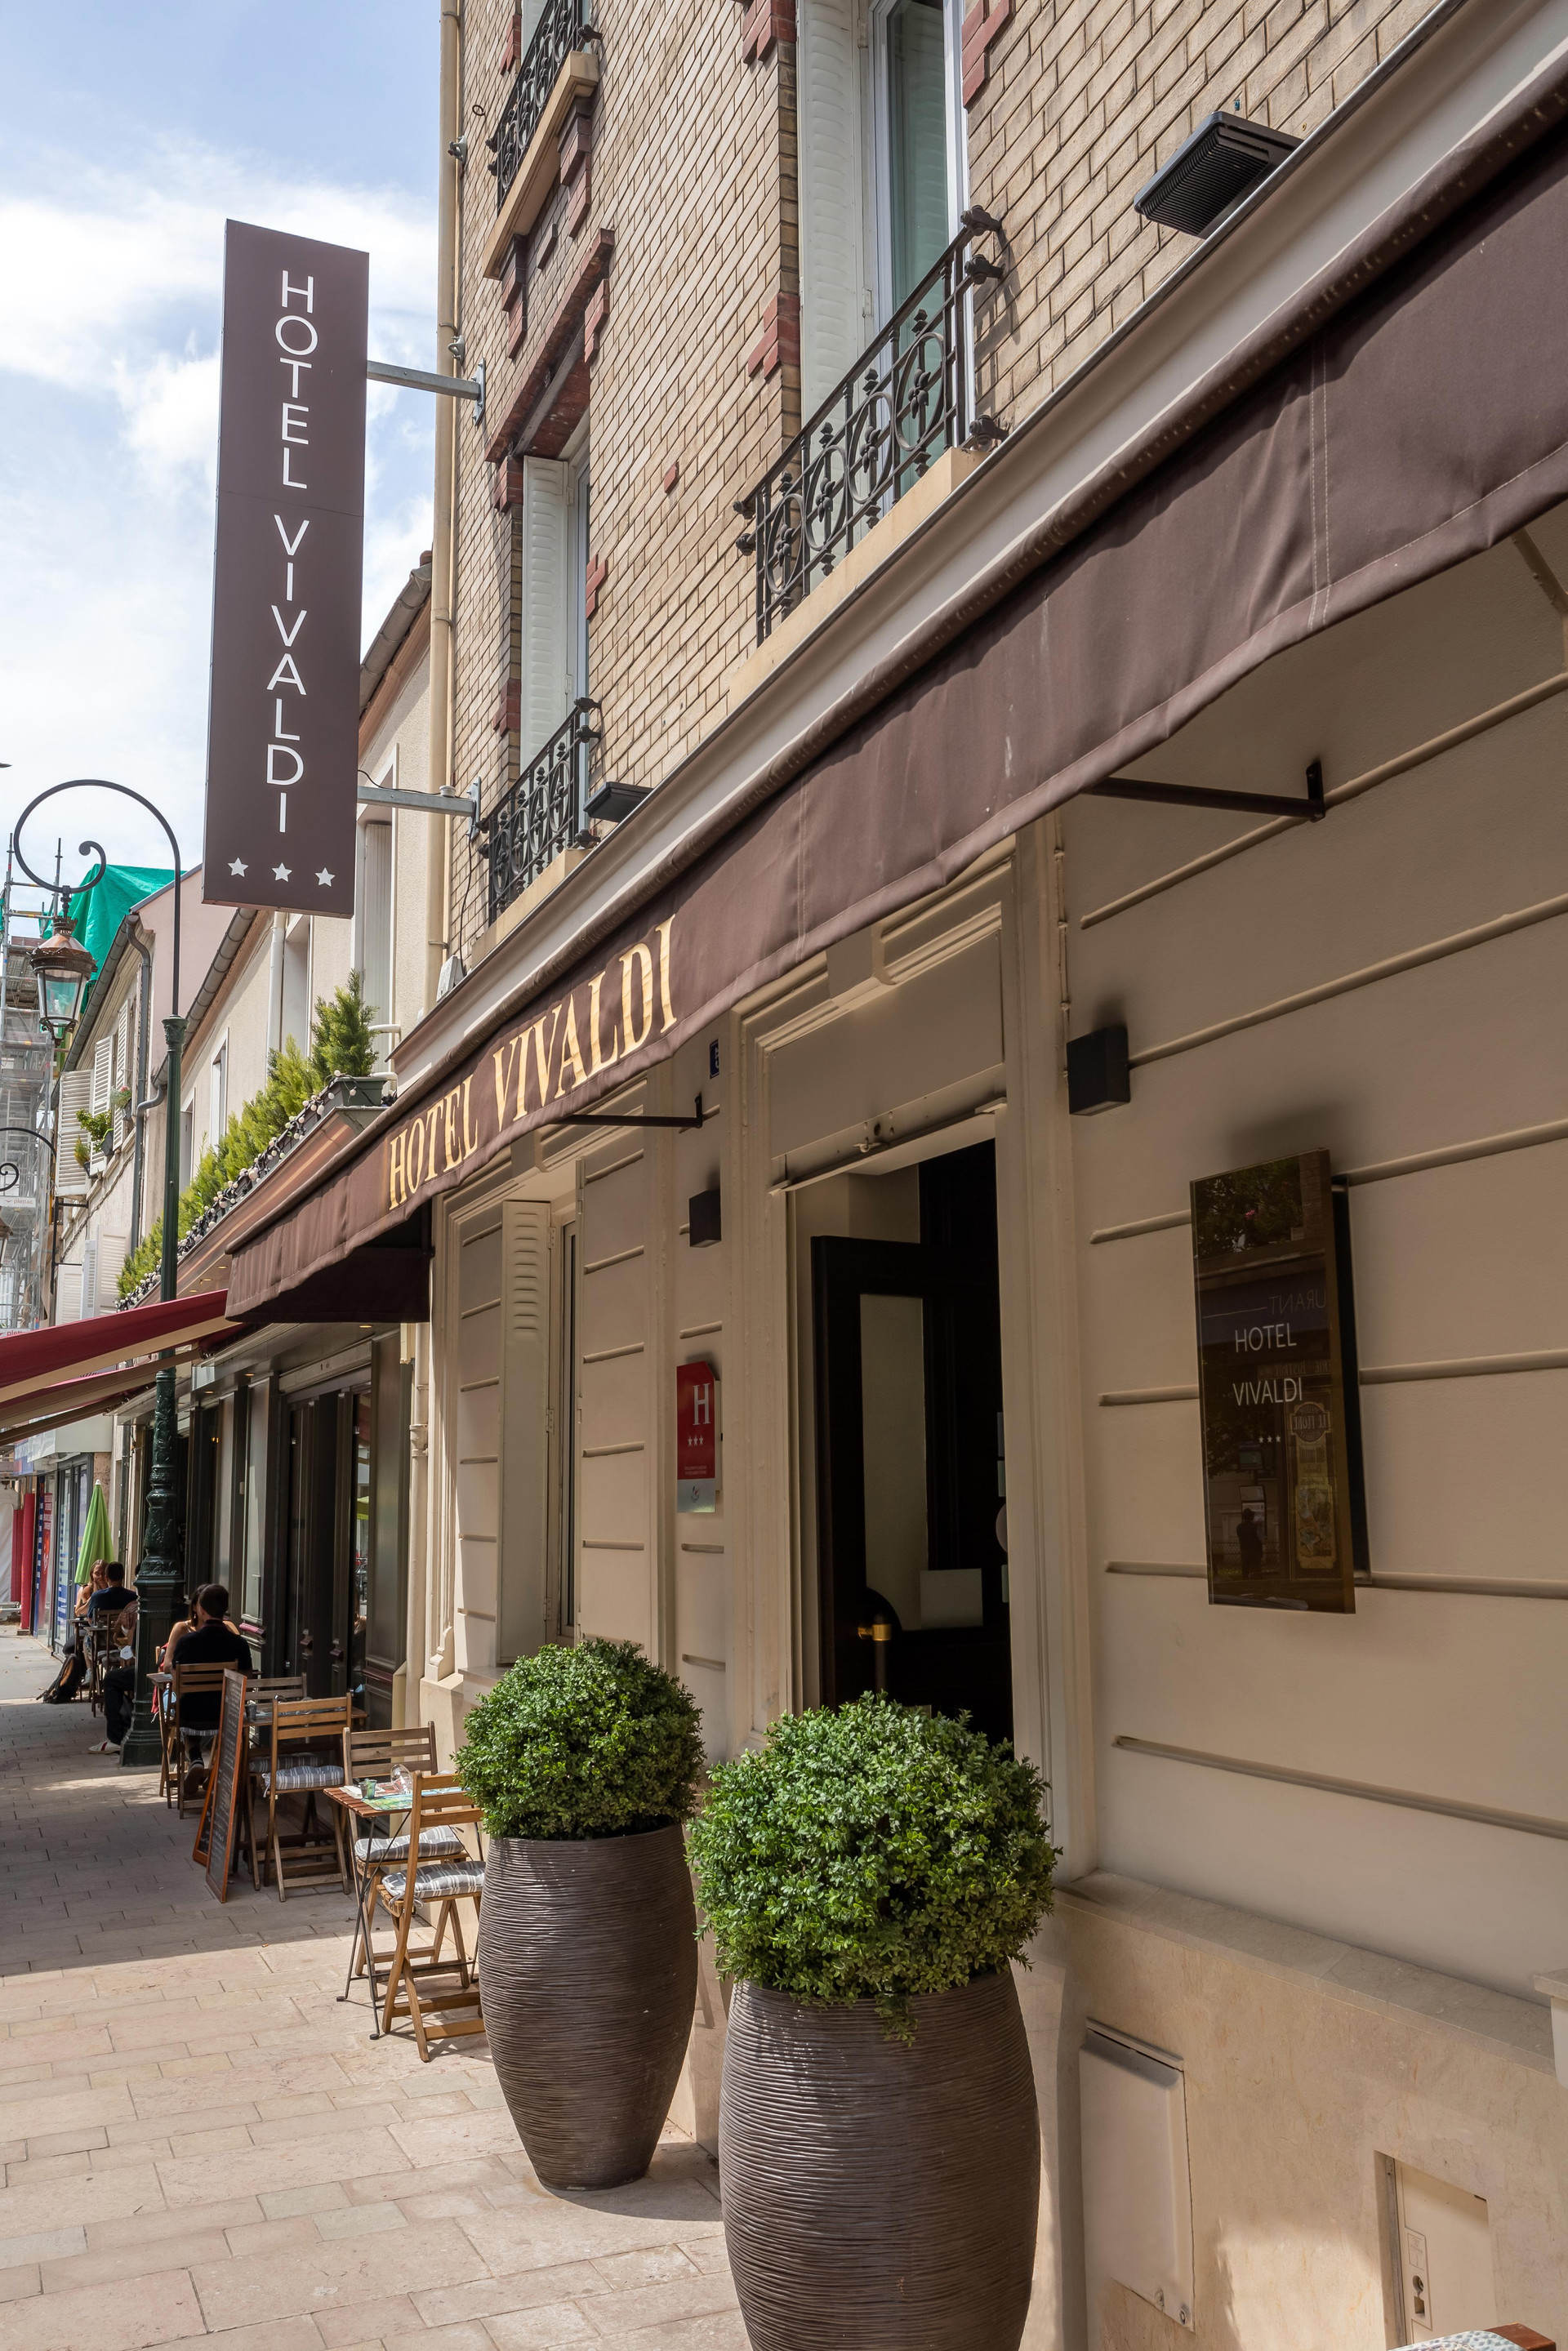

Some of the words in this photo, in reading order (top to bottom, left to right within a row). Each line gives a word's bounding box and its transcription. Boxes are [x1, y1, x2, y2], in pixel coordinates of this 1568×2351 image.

[274, 269, 318, 490] HOTEL
[265, 514, 310, 833] VIVALDI
[389, 1074, 479, 1210] HOTEL
[492, 914, 678, 1132] VIVALDI
[1232, 1377, 1303, 1406] VIVALDI
[1235, 1322, 1297, 1353] HOTEL
[693, 1383, 711, 1426] H
